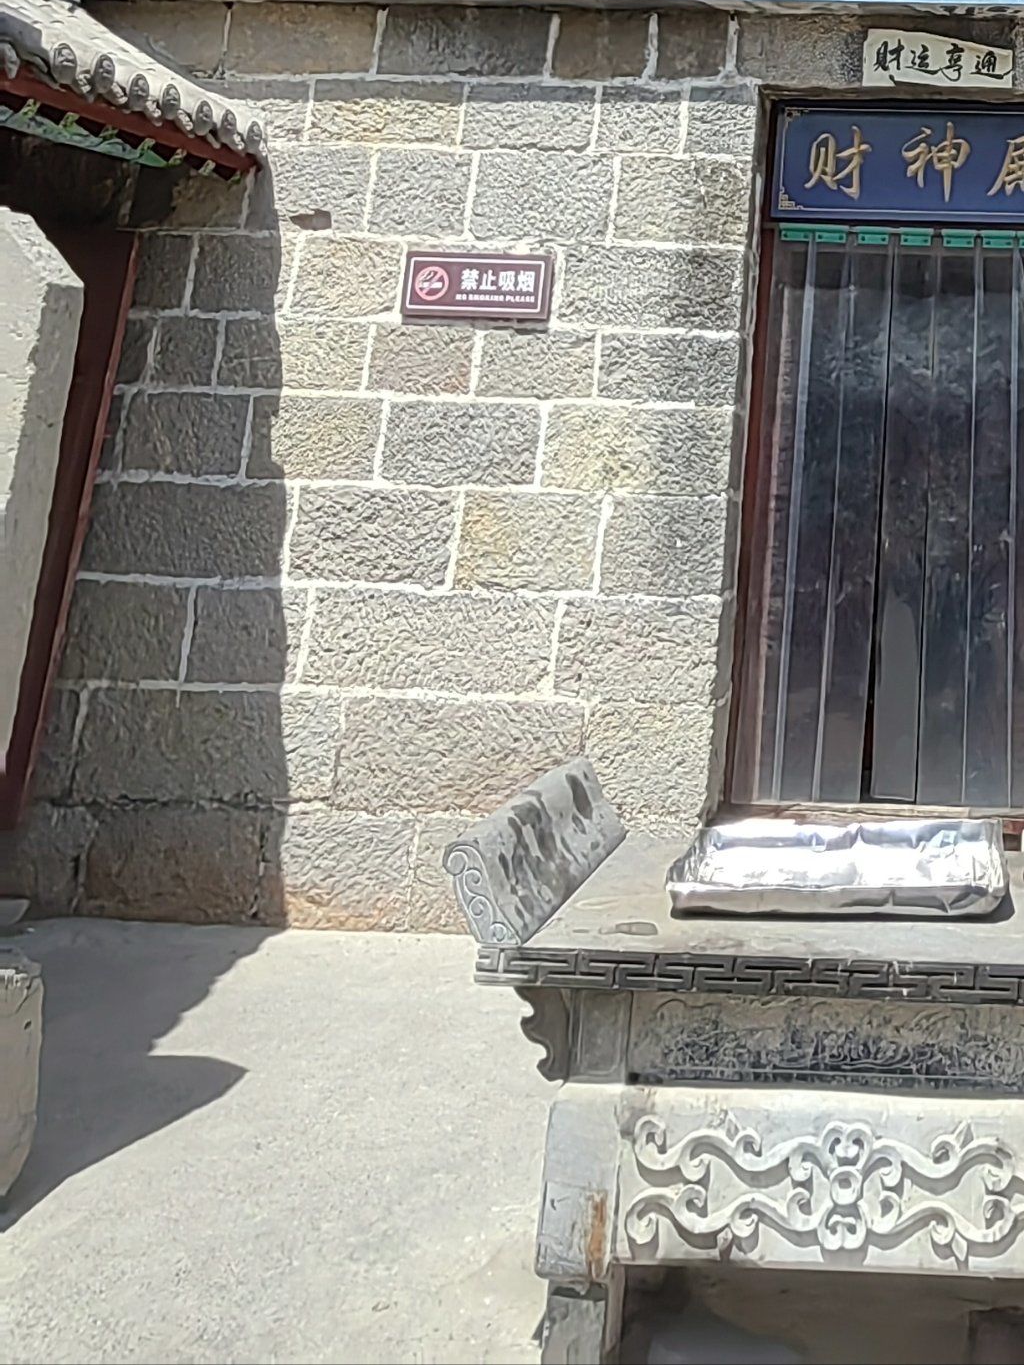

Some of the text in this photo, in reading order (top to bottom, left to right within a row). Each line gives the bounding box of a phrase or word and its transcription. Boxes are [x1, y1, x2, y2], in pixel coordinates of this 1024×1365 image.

[461, 268, 535, 293] 禁止吸烟
[455, 293, 535, 303] NO SMOKING PLEASE
